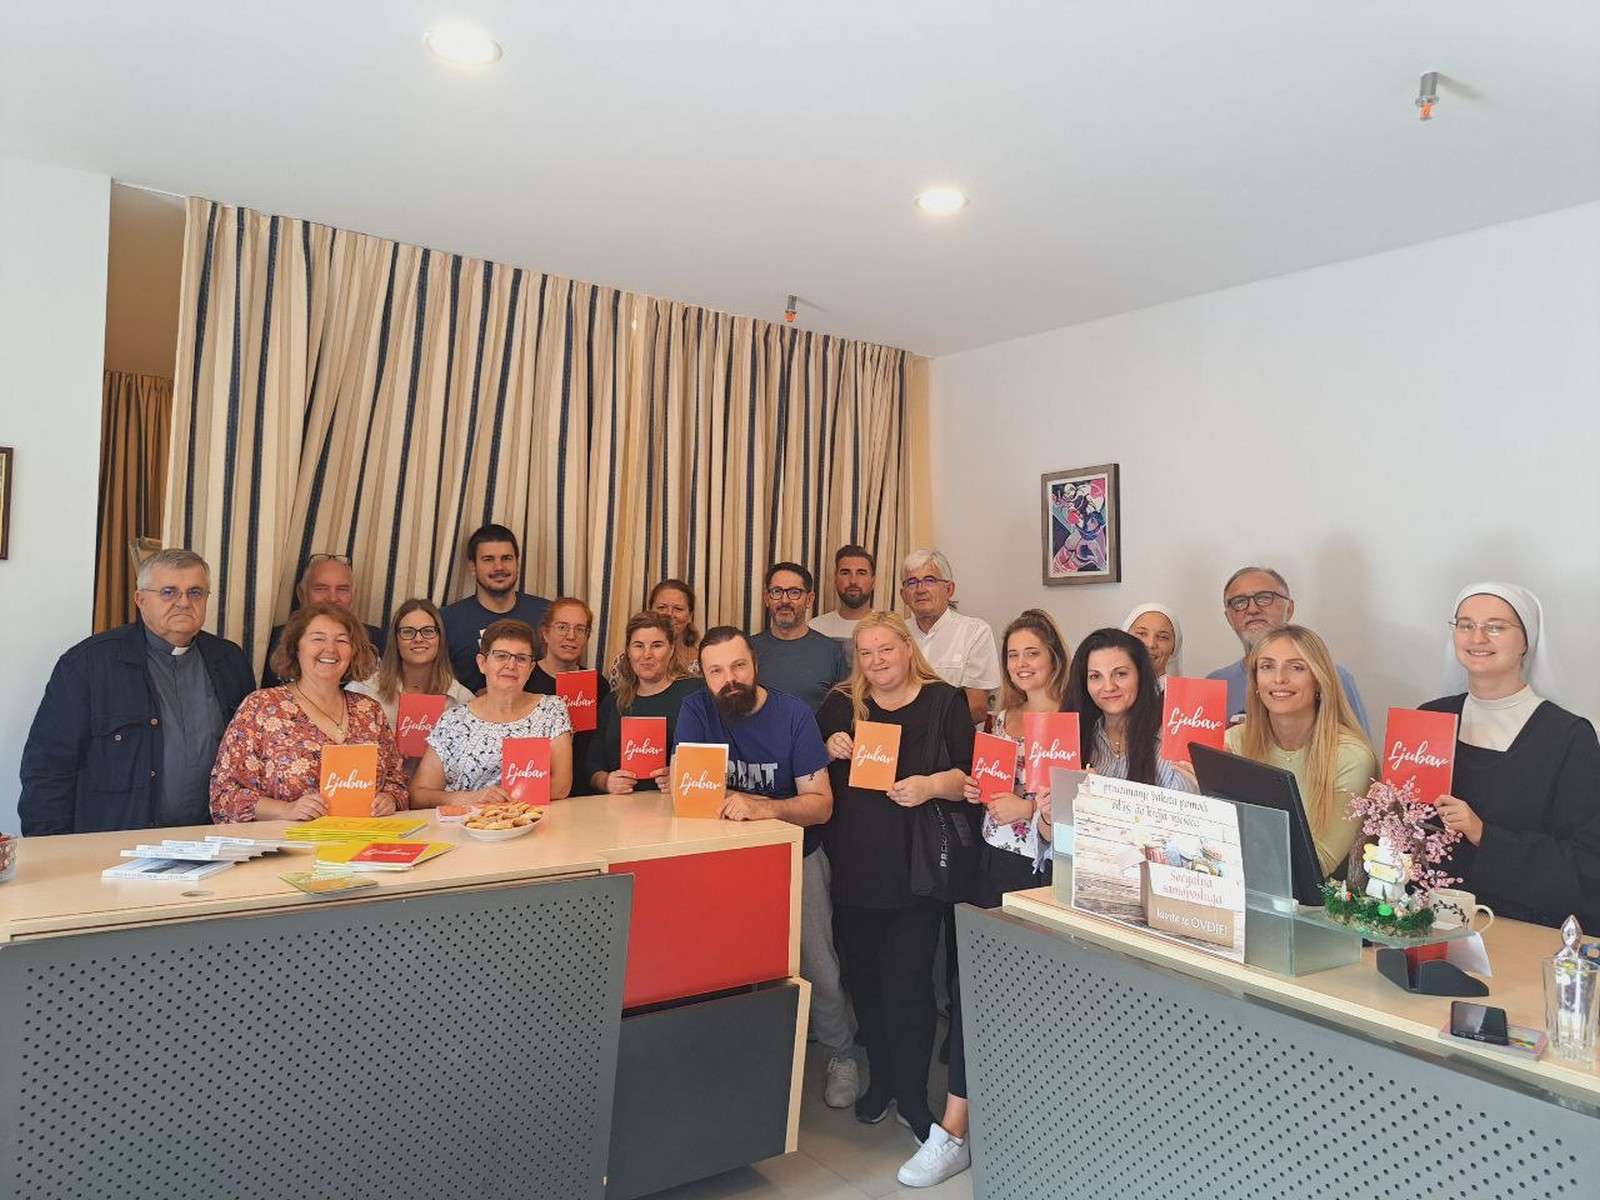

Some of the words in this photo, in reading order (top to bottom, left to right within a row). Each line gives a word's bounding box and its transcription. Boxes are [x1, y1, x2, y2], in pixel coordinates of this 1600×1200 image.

[562, 690, 597, 707] jubav
[399, 714, 432, 737] Ljuba
[1167, 706, 1224, 734] Ljubav
[624, 738, 662, 760] Ljubav
[855, 745, 894, 767] Ljubav
[1029, 739, 1076, 767] Ljubav
[1388, 740, 1450, 769] Ljubav
[505, 760, 548, 785] Ljubav
[975, 758, 1012, 780] Ljubav
[324, 769, 371, 797] Ljubav
[679, 770, 722, 796] Ljubav
